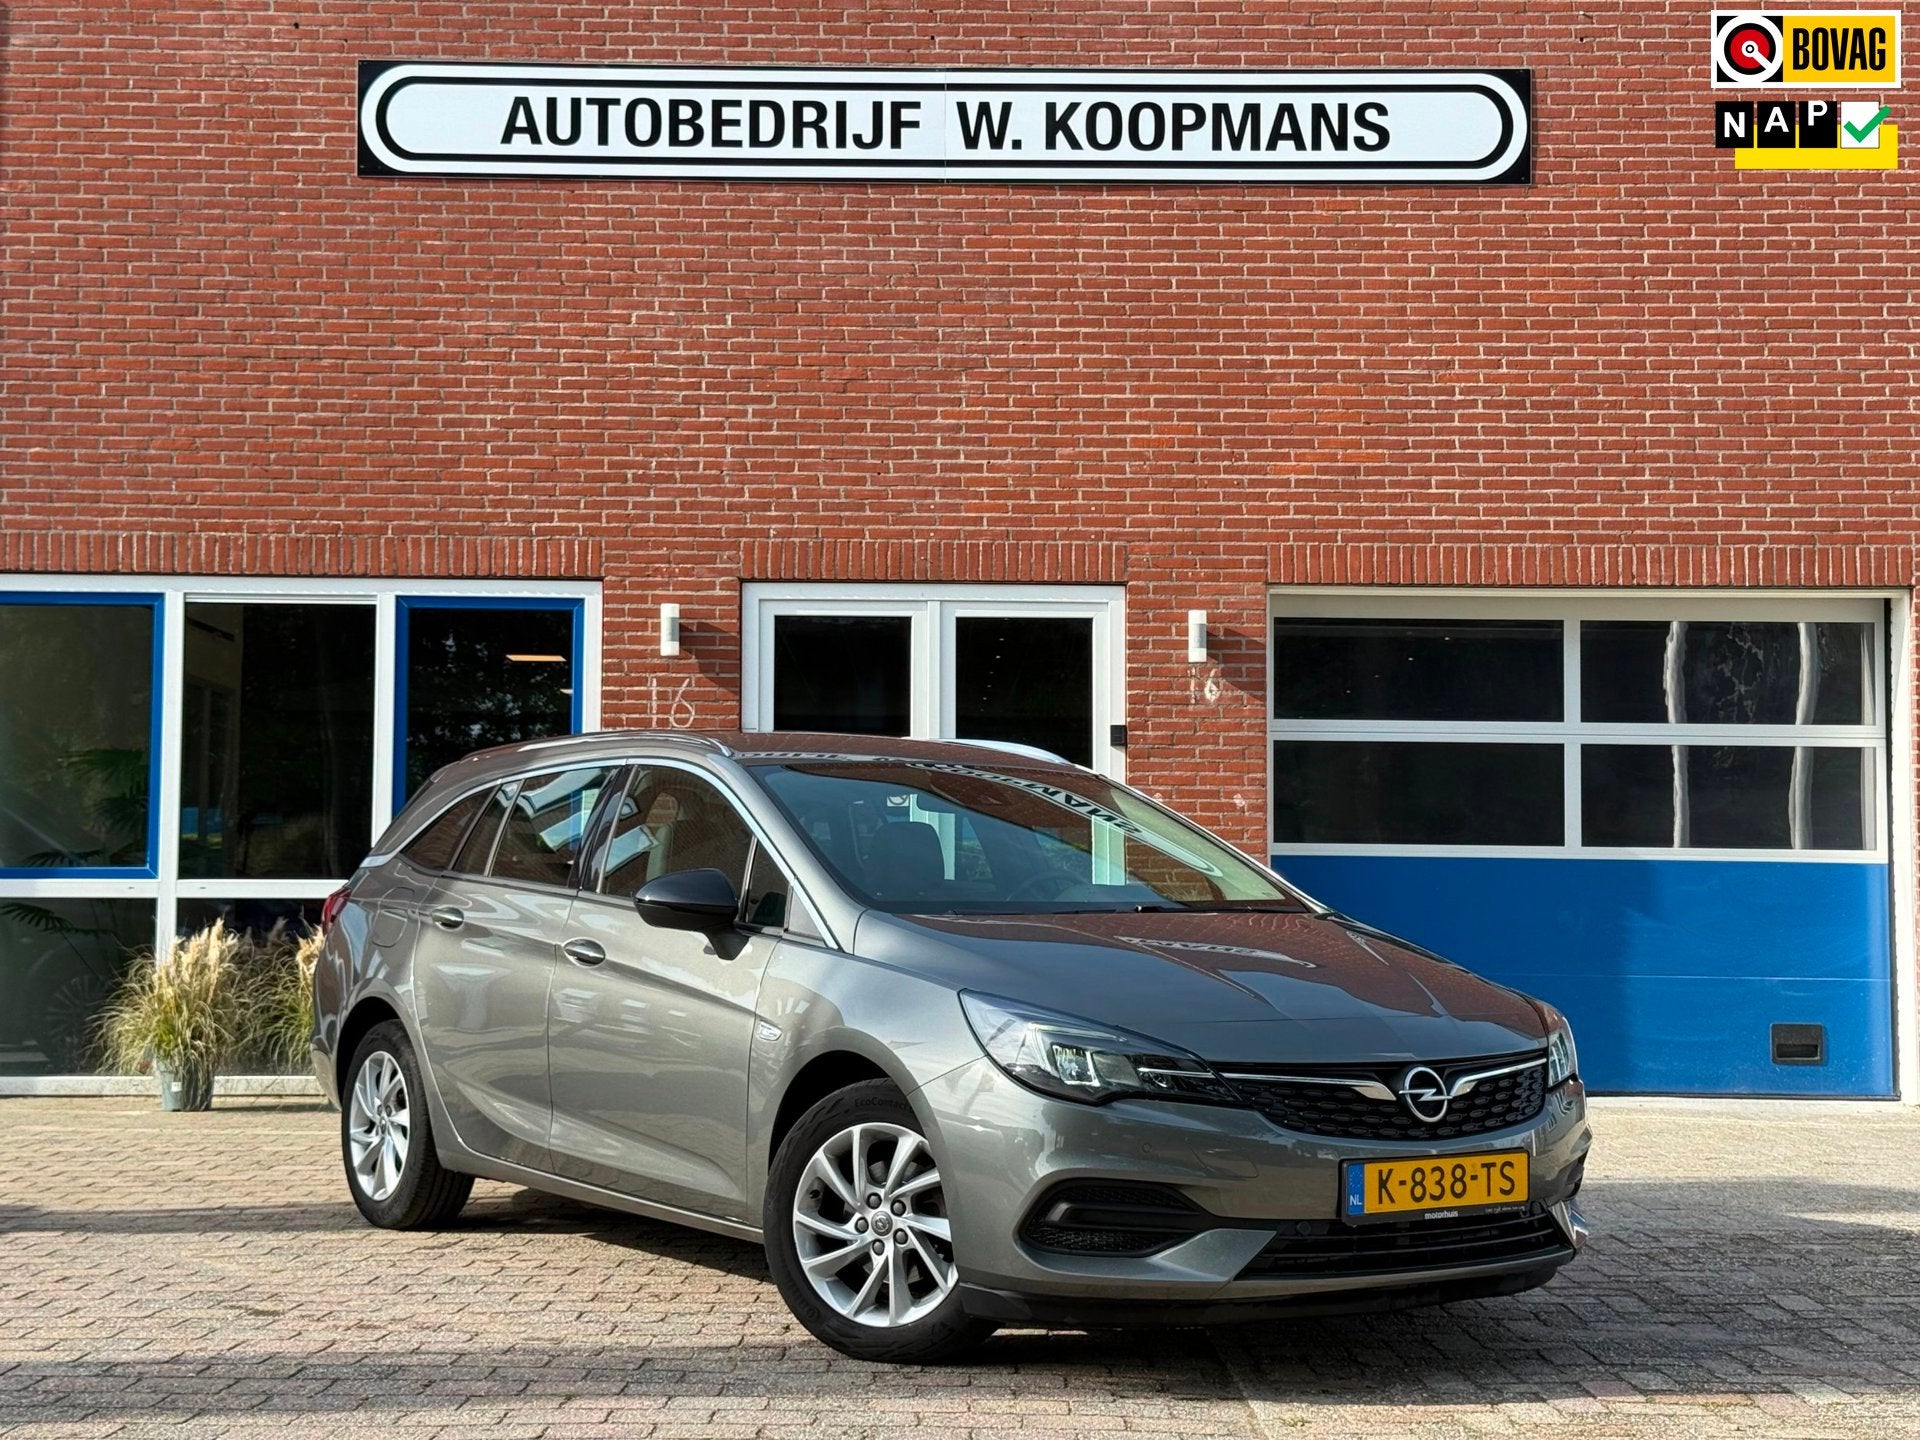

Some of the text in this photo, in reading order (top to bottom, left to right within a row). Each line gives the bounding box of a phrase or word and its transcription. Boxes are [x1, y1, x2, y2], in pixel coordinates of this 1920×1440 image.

[500, 96, 1391, 152] AUTOBEDRIJF W. KOOPMANS
[651, 678, 695, 728] 16
[1349, 1194, 1363, 1206] NL
[1377, 1161, 1516, 1205] K-838-TS
